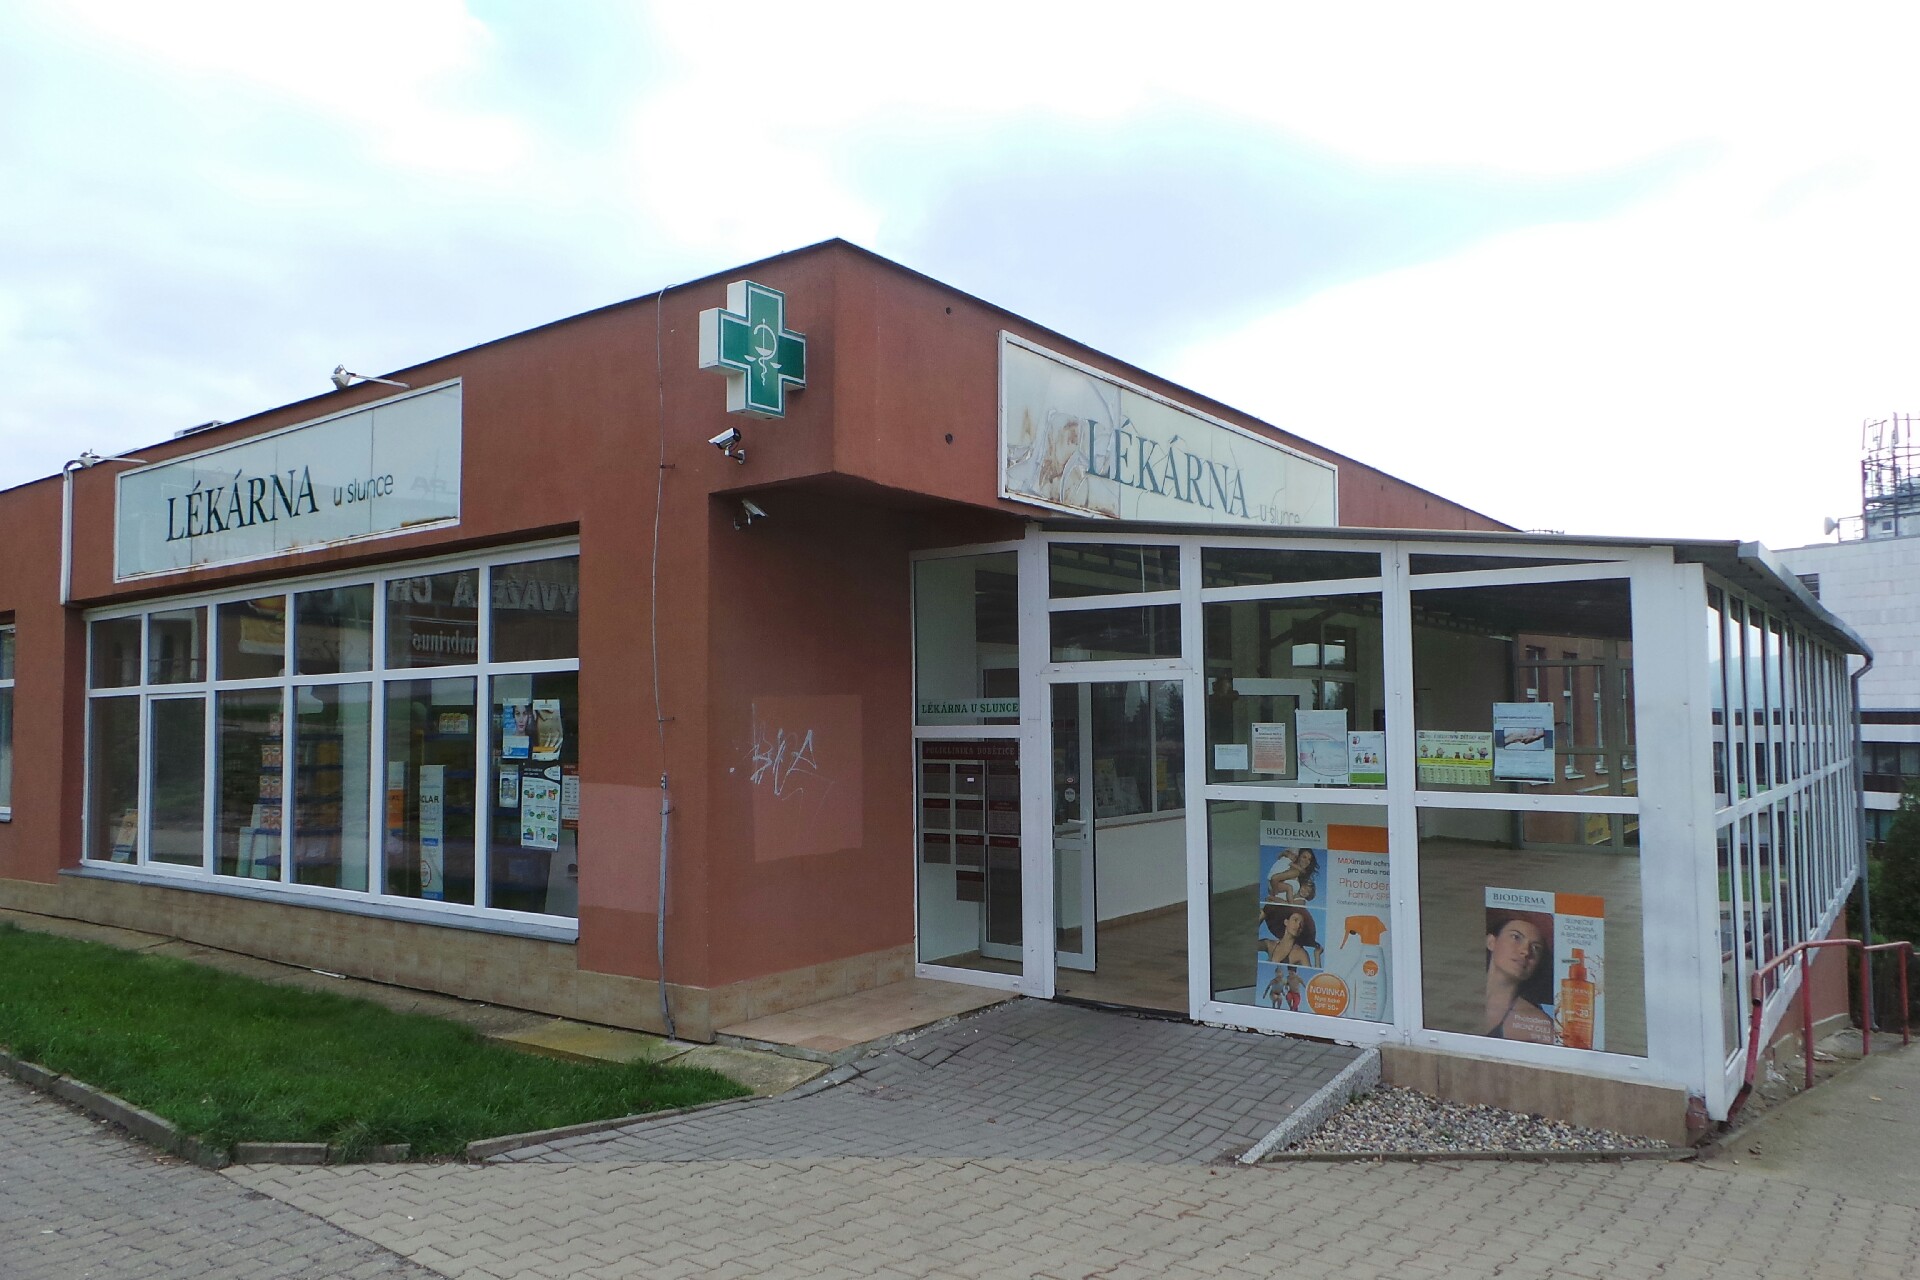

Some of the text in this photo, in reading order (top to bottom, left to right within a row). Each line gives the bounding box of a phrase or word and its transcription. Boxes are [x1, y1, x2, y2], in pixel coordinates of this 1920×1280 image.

[1086, 414, 1251, 518] LÉKÁRNA
[166, 464, 320, 542] LÉKÁRNA
[333, 486, 342, 507] u
[347, 474, 394, 503] slunce
[921, 701, 1019, 714] LÉKÁRNA U SLUNCE
[1266, 827, 1321, 839] BIODERMA
[1493, 893, 1546, 905] BIODERMA
[1309, 986, 1346, 997] NOVINKA
